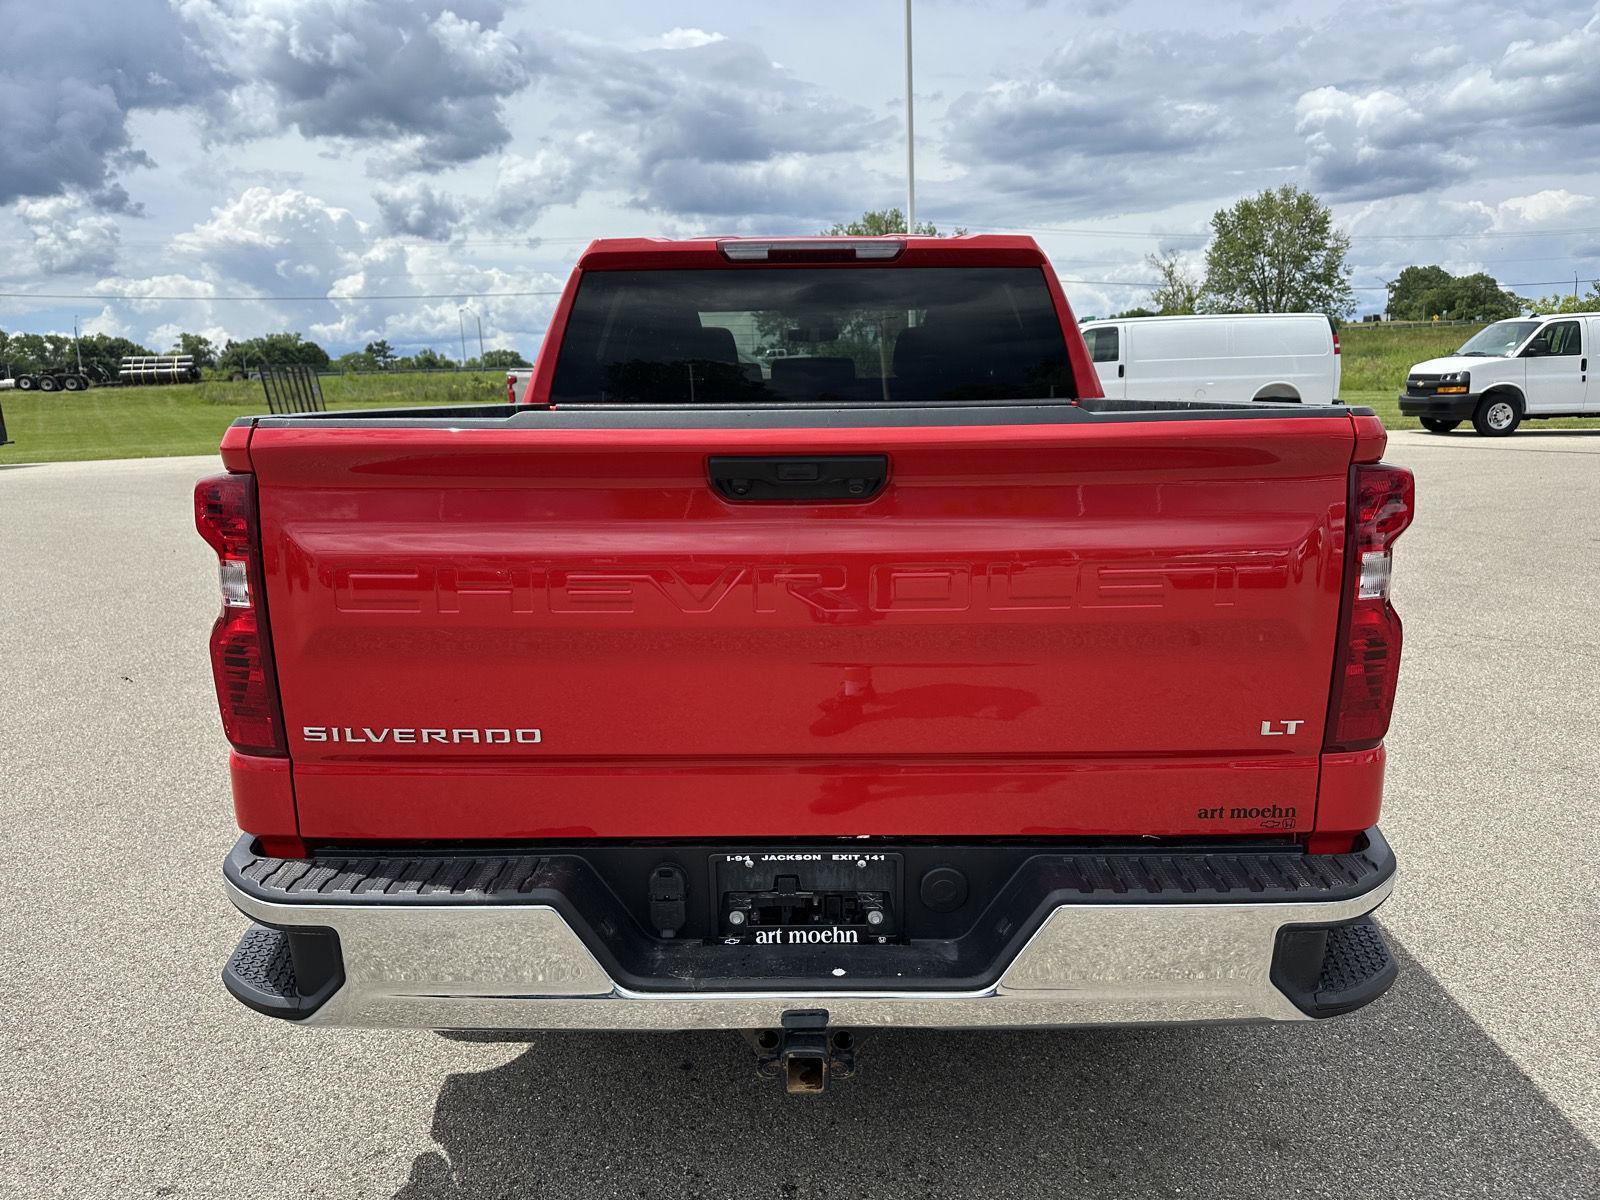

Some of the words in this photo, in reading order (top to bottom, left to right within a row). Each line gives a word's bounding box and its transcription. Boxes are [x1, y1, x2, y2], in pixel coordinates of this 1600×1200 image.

[334, 562, 1288, 614] CHEVROLET
[303, 726, 542, 744] SILVERADO
[1261, 720, 1304, 735] LT
[1197, 806, 1226, 819] art
[1229, 804, 1297, 819] moehn
[755, 928, 782, 944] art
[788, 926, 859, 944] moehn
